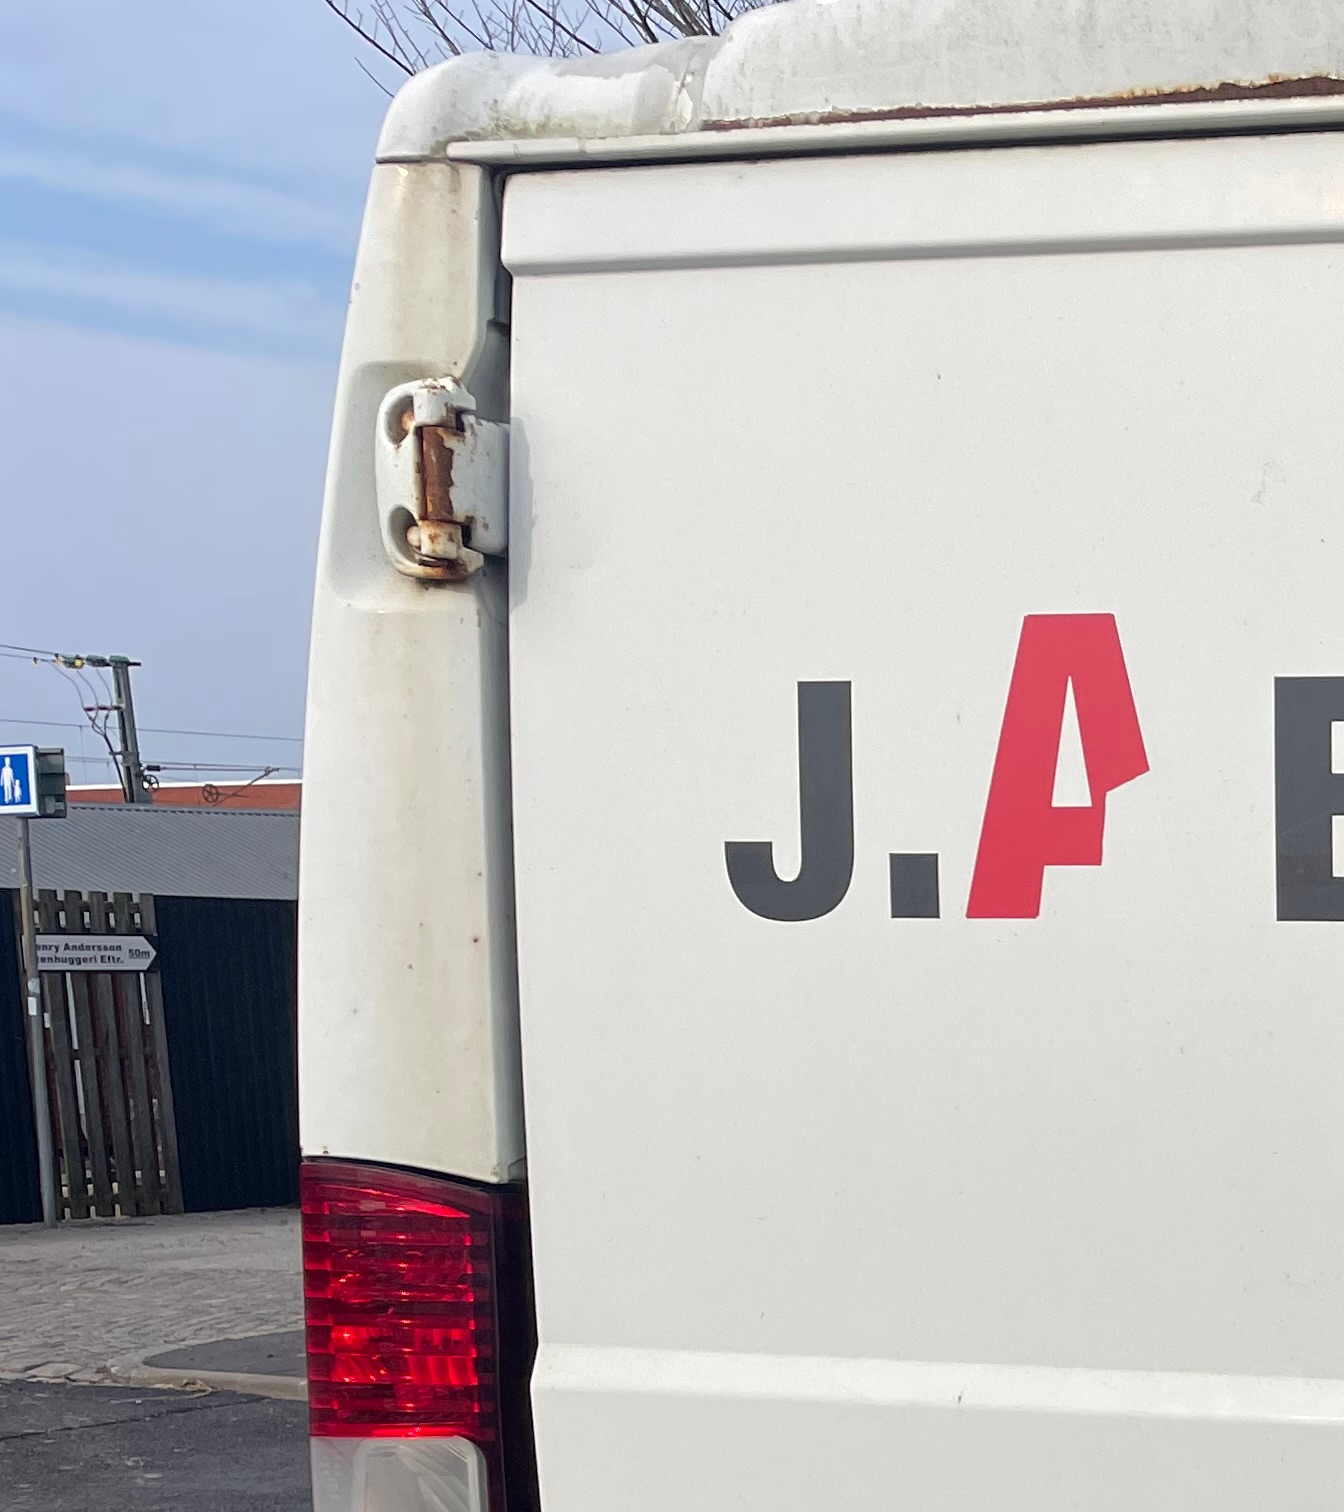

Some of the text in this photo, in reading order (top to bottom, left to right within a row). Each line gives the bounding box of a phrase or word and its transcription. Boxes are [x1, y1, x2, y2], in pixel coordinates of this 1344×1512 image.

[35, 942, 122, 954] enry Andersson
[128, 948, 151, 959] 50m
